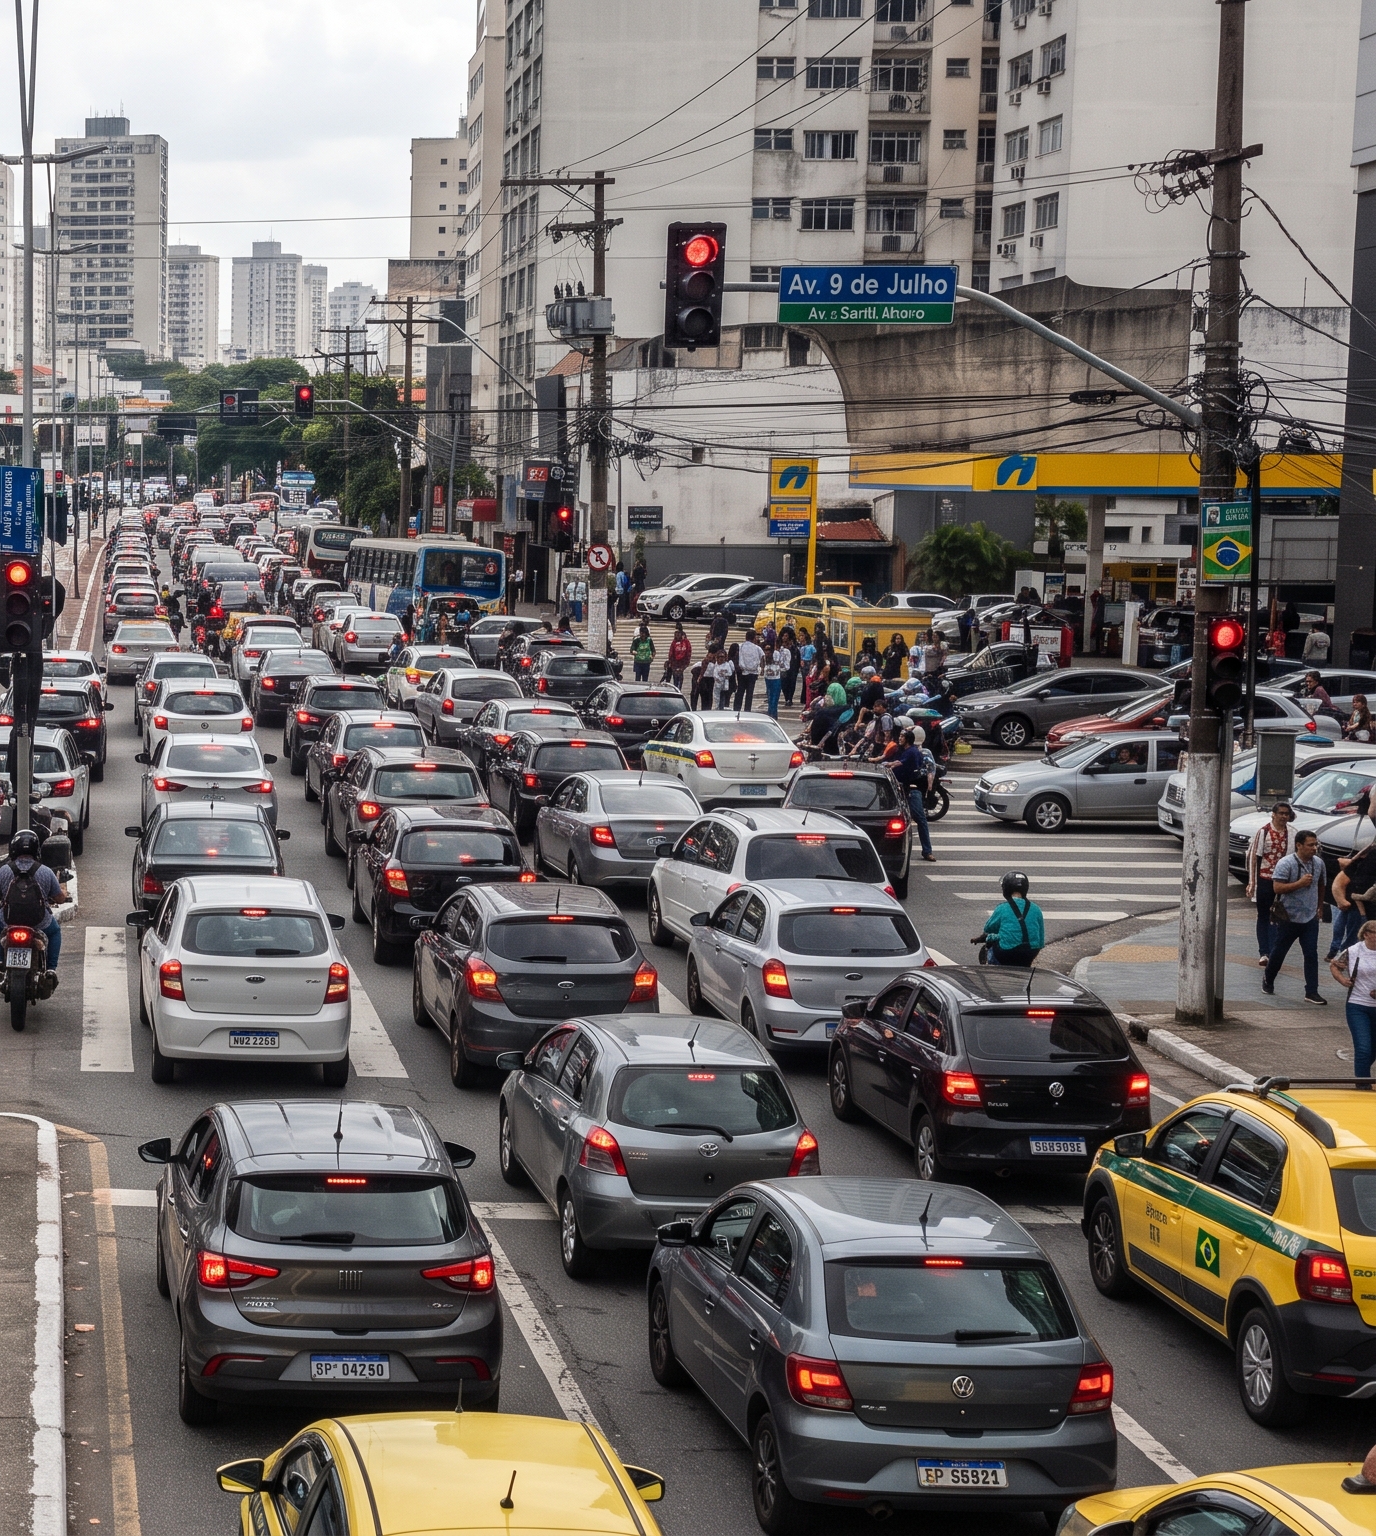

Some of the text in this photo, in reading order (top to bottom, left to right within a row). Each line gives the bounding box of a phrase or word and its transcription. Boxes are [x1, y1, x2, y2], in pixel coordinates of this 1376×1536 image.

[788, 272, 948, 295] Av. 9 de Julho
[342, 1362, 384, 1377] 04250
